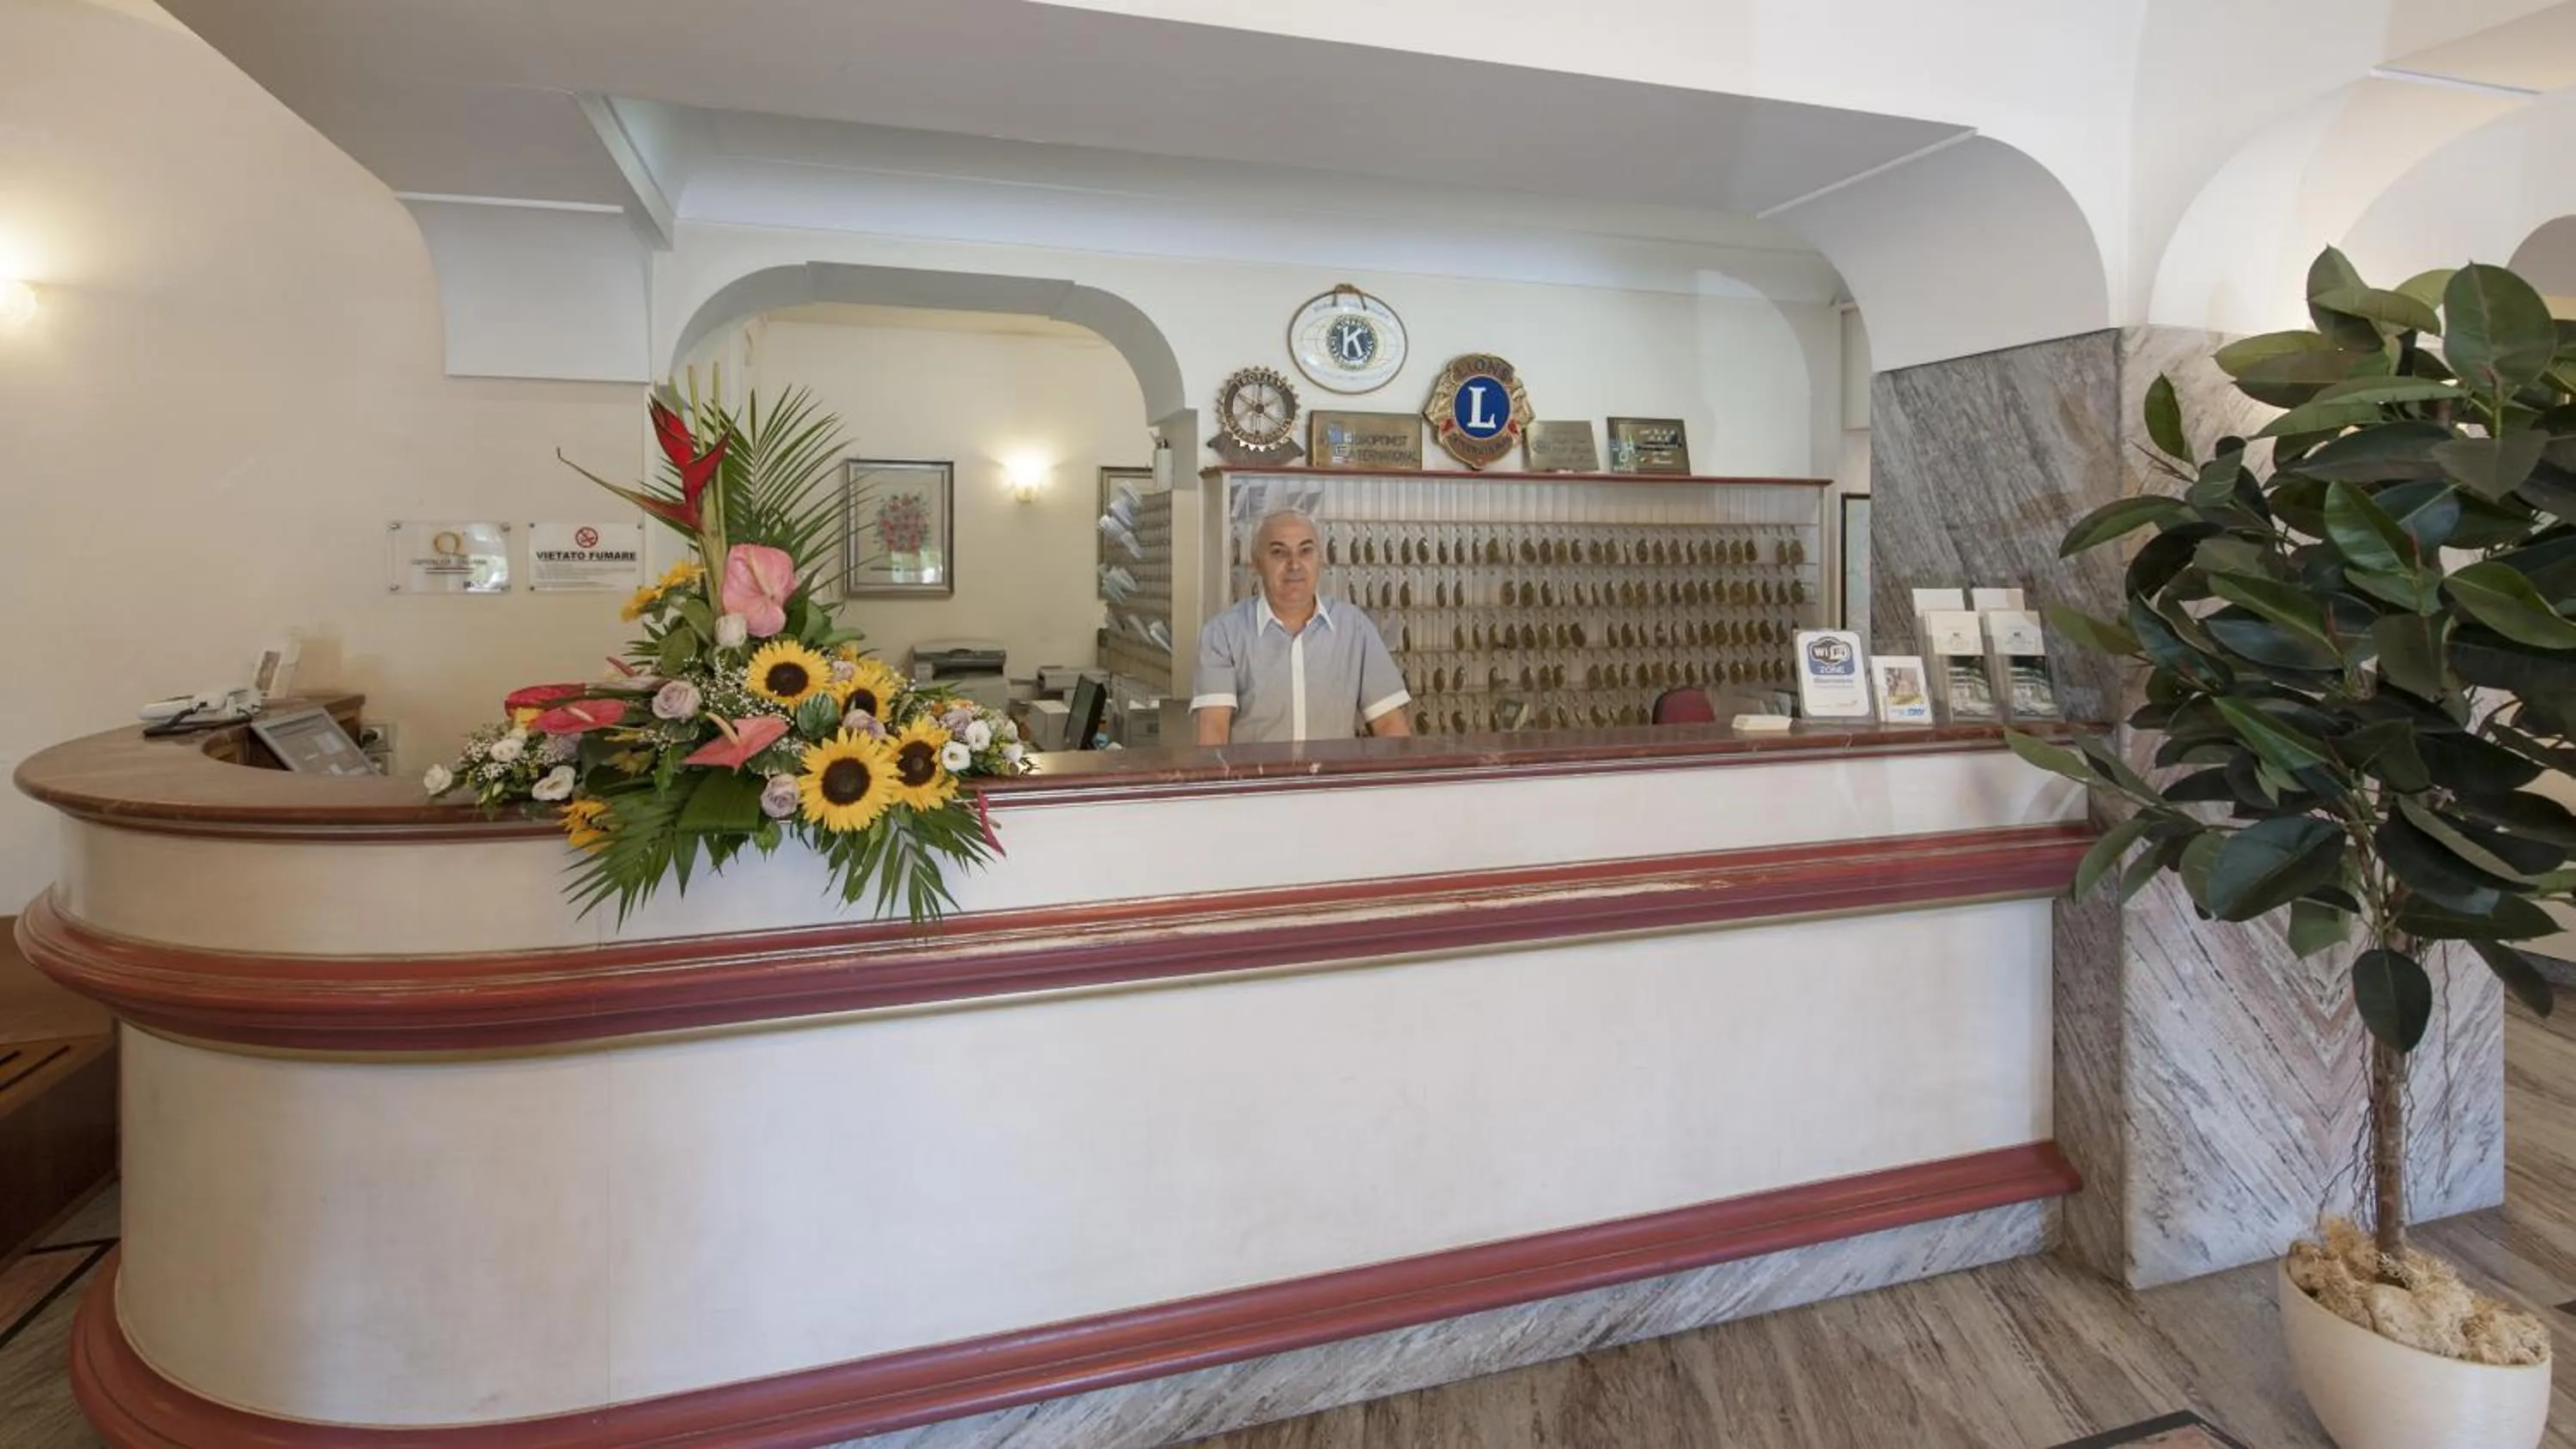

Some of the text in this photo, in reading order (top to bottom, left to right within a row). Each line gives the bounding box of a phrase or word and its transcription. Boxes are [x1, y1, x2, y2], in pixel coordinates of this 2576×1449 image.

[1341, 325, 1368, 358] K
[1452, 359, 1512, 382] LIONS
[1467, 385, 1497, 429] L
[536, 551, 636, 561] VIETATO FUMARE
